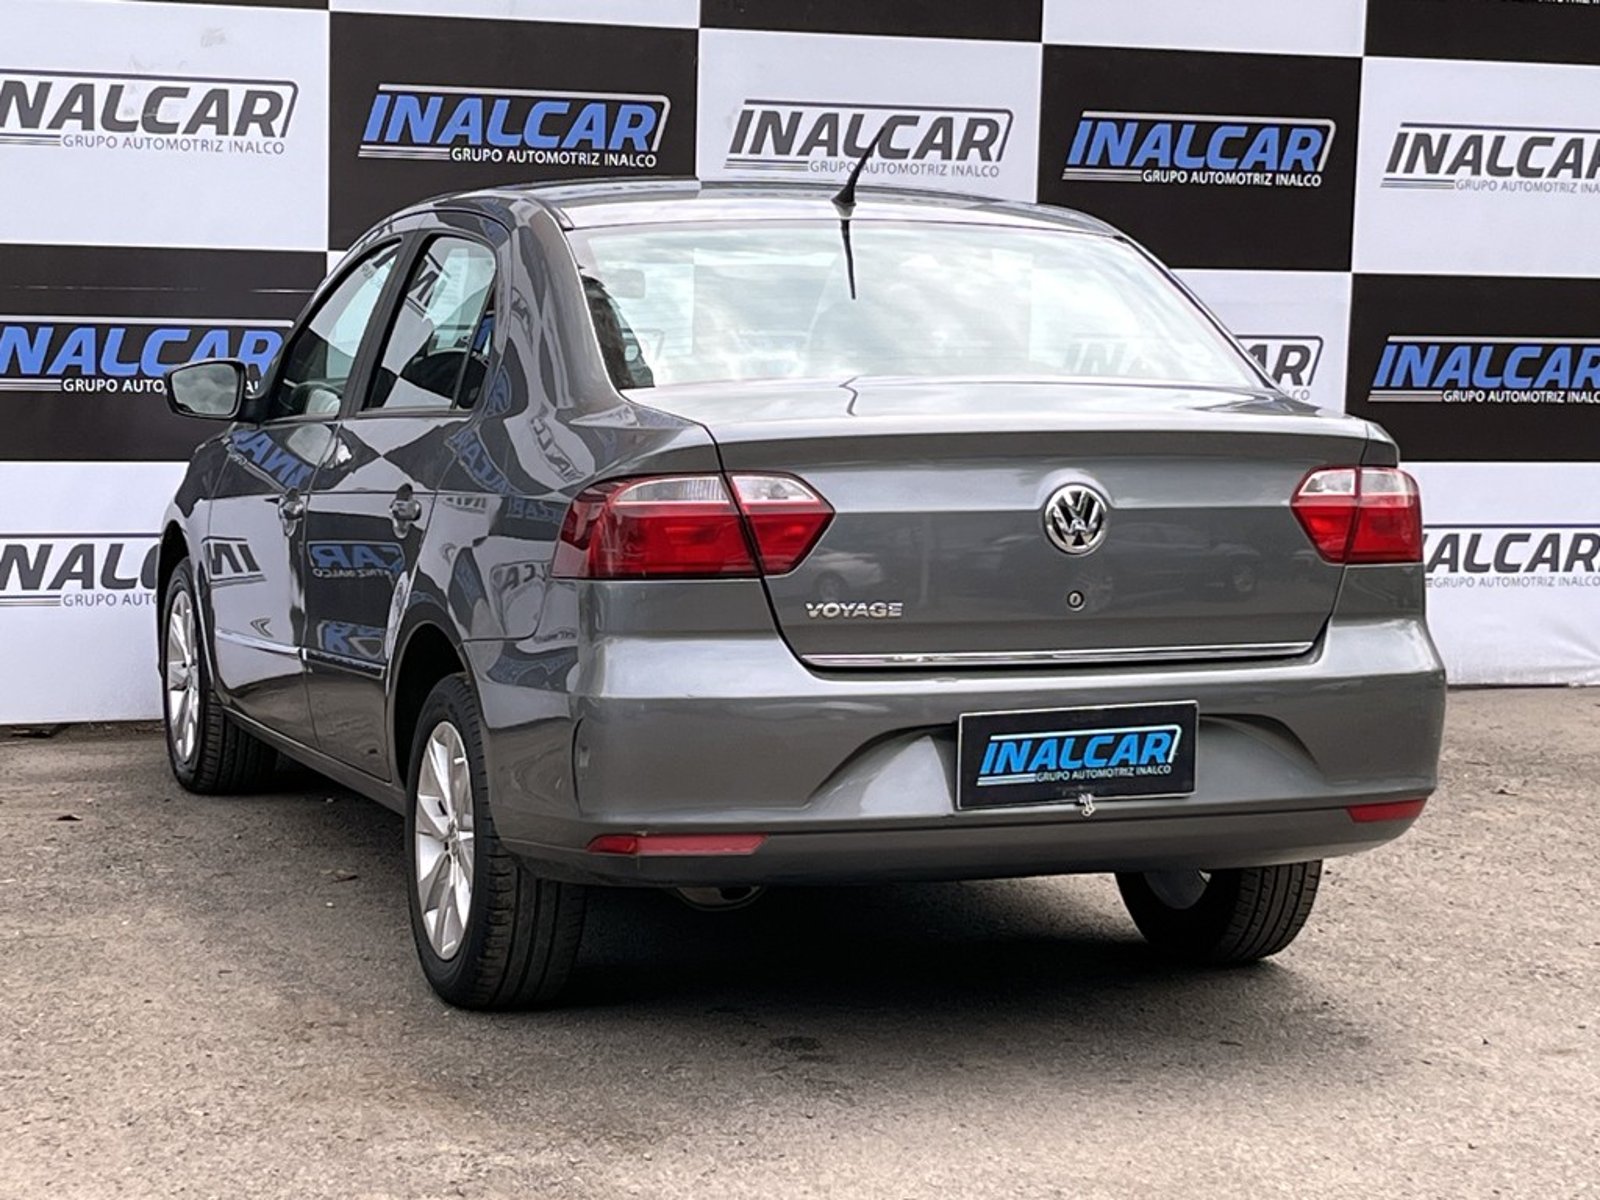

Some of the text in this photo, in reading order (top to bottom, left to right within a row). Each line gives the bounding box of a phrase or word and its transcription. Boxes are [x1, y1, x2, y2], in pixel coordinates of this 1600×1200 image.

[363, 94, 657, 151] INALCAR
[729, 110, 1001, 161] INALCAR
[62, 134, 285, 155] GRUPO AUTOMOTRIZ INALCO
[1066, 120, 1323, 171] INALCAR
[452, 148, 657, 168] GRUPO AUTOMOTRIZ INALCO
[810, 160, 858, 173] GRUPO
[951, 164, 1000, 177] INALCO
[1143, 170, 1322, 187] GRUPO AUTOMOTRIZ INALCO
[1456, 179, 1497, 191] GRUPO
[1500, 180, 1577, 193] AUTOMOTRIZ
[62, 378, 118, 393] GRUPO
[1443, 390, 1485, 402] GRUPO
[1488, 391, 1565, 403] AUTOMOTRIZ
[1423, 533, 1595, 573] ALCAR
[1433, 575, 1600, 588] GRUPO AUTOMOTRIZ INALCO
[63, 593, 117, 607] GRUPO
[805, 602, 904, 618] VOYAGE
[980, 732, 1172, 775] INALCAR
[1036, 765, 1172, 782] GRUPO AUTOMOTRIZ INALCO
